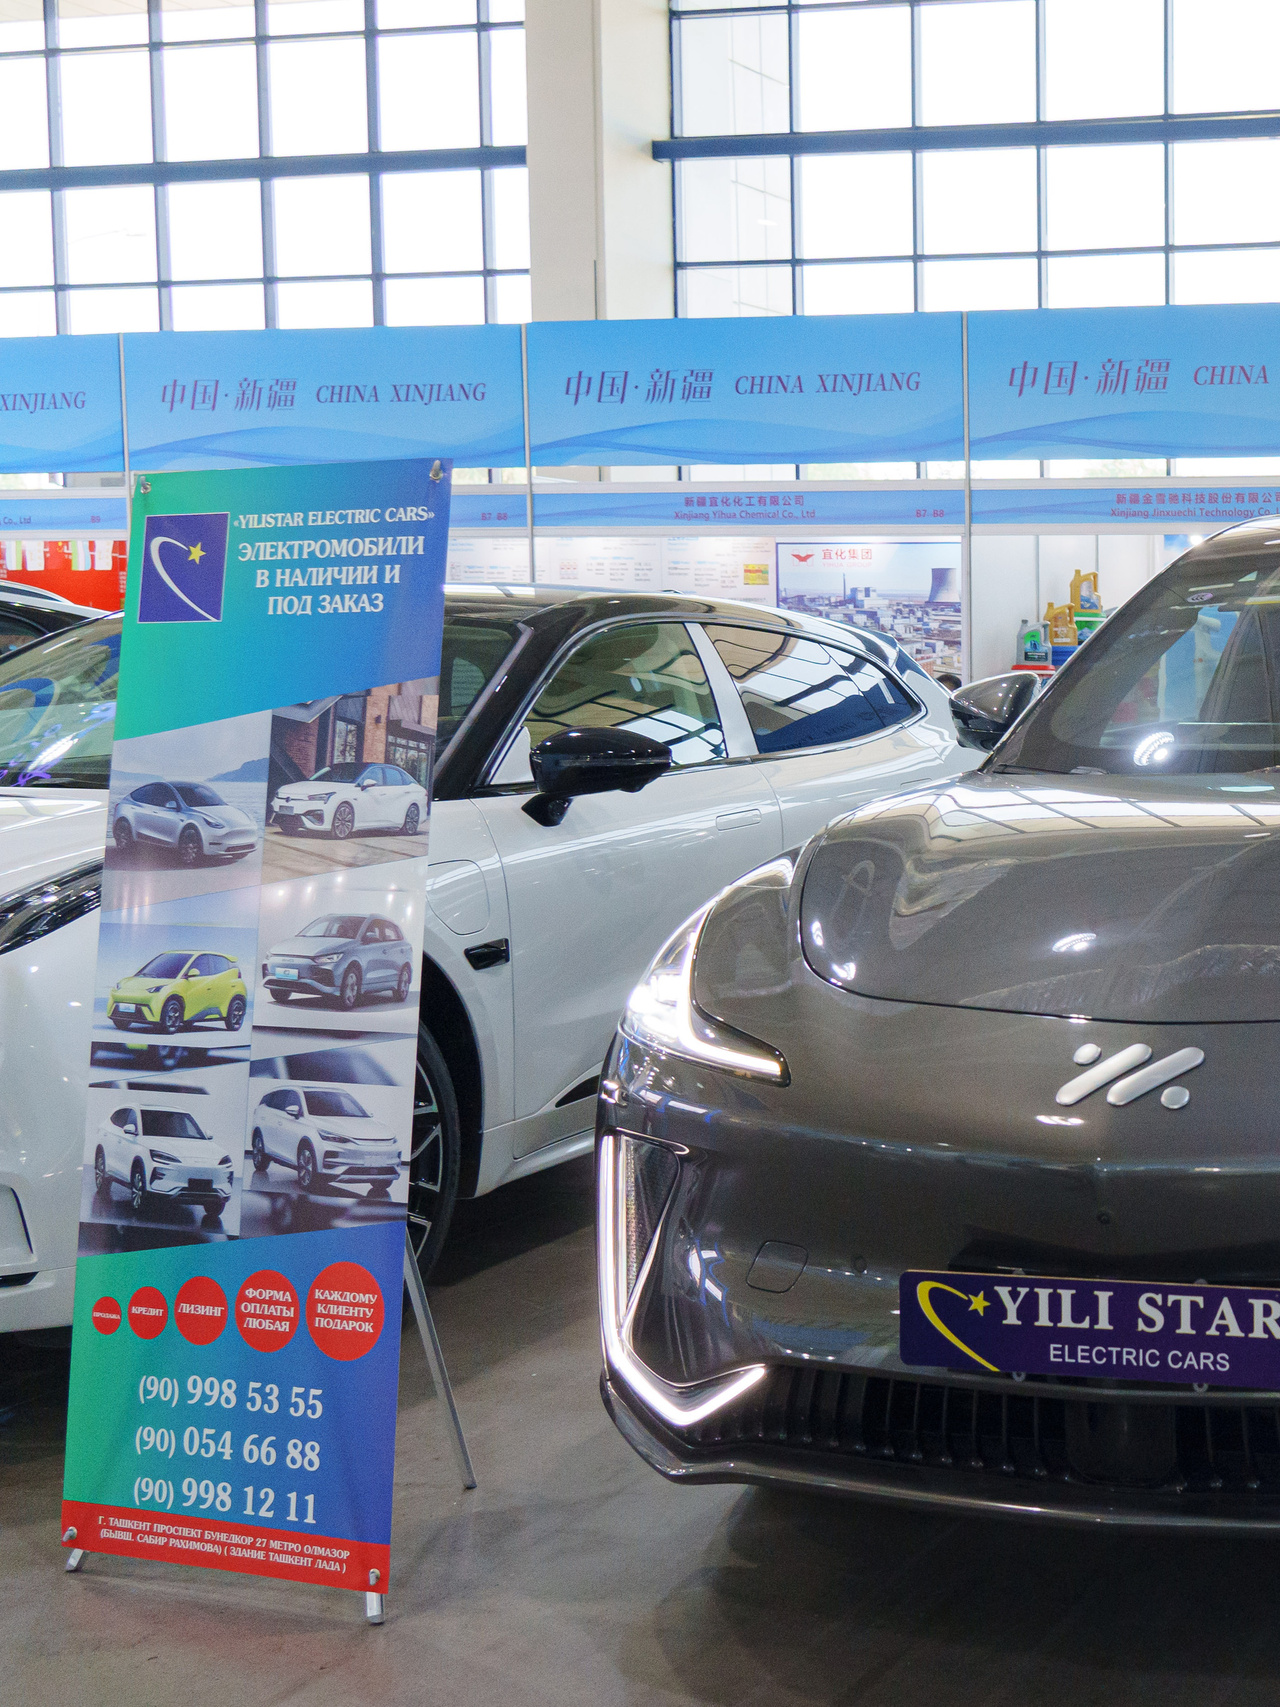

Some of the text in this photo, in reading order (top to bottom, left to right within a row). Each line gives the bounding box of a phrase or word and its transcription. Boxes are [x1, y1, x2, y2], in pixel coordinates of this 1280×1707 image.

[735, 372, 920, 396] CHINA XINJIANG
[1008, 358, 1171, 398] 中国·新疆
[1193, 365, 1269, 386] CHINA
[161, 377, 297, 413] 中国·新疆
[316, 383, 487, 405] CHINA XINJIANG
[565, 368, 715, 406] 中国·新疆
[0, 391, 86, 413] XINJIANG
[684, 495, 804, 507] 新疆宜化化工有限公司
[233, 506, 435, 528] «YILISTAR ELECTRIC CARS»
[674, 511, 709, 521] Xinjiang
[712, 510, 737, 519] Yihua
[739, 509, 779, 519] Chemical
[1110, 508, 1149, 519] Xinjiang
[1152, 507, 1196, 517] Jinxuechi
[1200, 507, 1254, 518] Technology
[238, 536, 425, 561] ЭЛЕКТРОМОБИЛИ
[822, 548, 872, 560] 宜化集团
[255, 564, 401, 588] В НАЛИЧИИ И
[268, 593, 384, 616] ПОД ЗАКАЗ
[245, 1287, 292, 1302] ФОРМА
[314, 1289, 378, 1304] КАЖДОМУ
[131, 1305, 164, 1317] КРЕДИТ
[178, 1303, 225, 1317] ЛИЗИНГ
[240, 1302, 295, 1317] ОПЛАТЫ
[316, 1303, 374, 1319] КЛИЕНТУ
[994, 1286, 1114, 1330] YILI
[243, 1317, 290, 1332] ЛЮБАЯ
[314, 1317, 374, 1333] ПОДАРОК
[1050, 1343, 1230, 1371] ELECTRIC CARS
[139, 1375, 323, 1419] (90) 998 53 55
[135, 1426, 320, 1471] (90) 054 66 88
[134, 1477, 316, 1524] (90) 998 12 11
[98, 1516, 350, 1559] Г. ТАШКЕНТ ПРОСПЕКТ БУНЕДКОР 27 МЕТРО ОЛМАЗОР
[100, 1528, 134, 1541] (БЫВШ.
[137, 1533, 168, 1546] САБИР
[169, 1538, 222, 1555] РАХИМОВА)
[229, 1547, 266, 1560] ЗДАНИЕ
[268, 1552, 313, 1567] ТАШКЕНТ
[314, 1559, 340, 1571] ЛАДА
